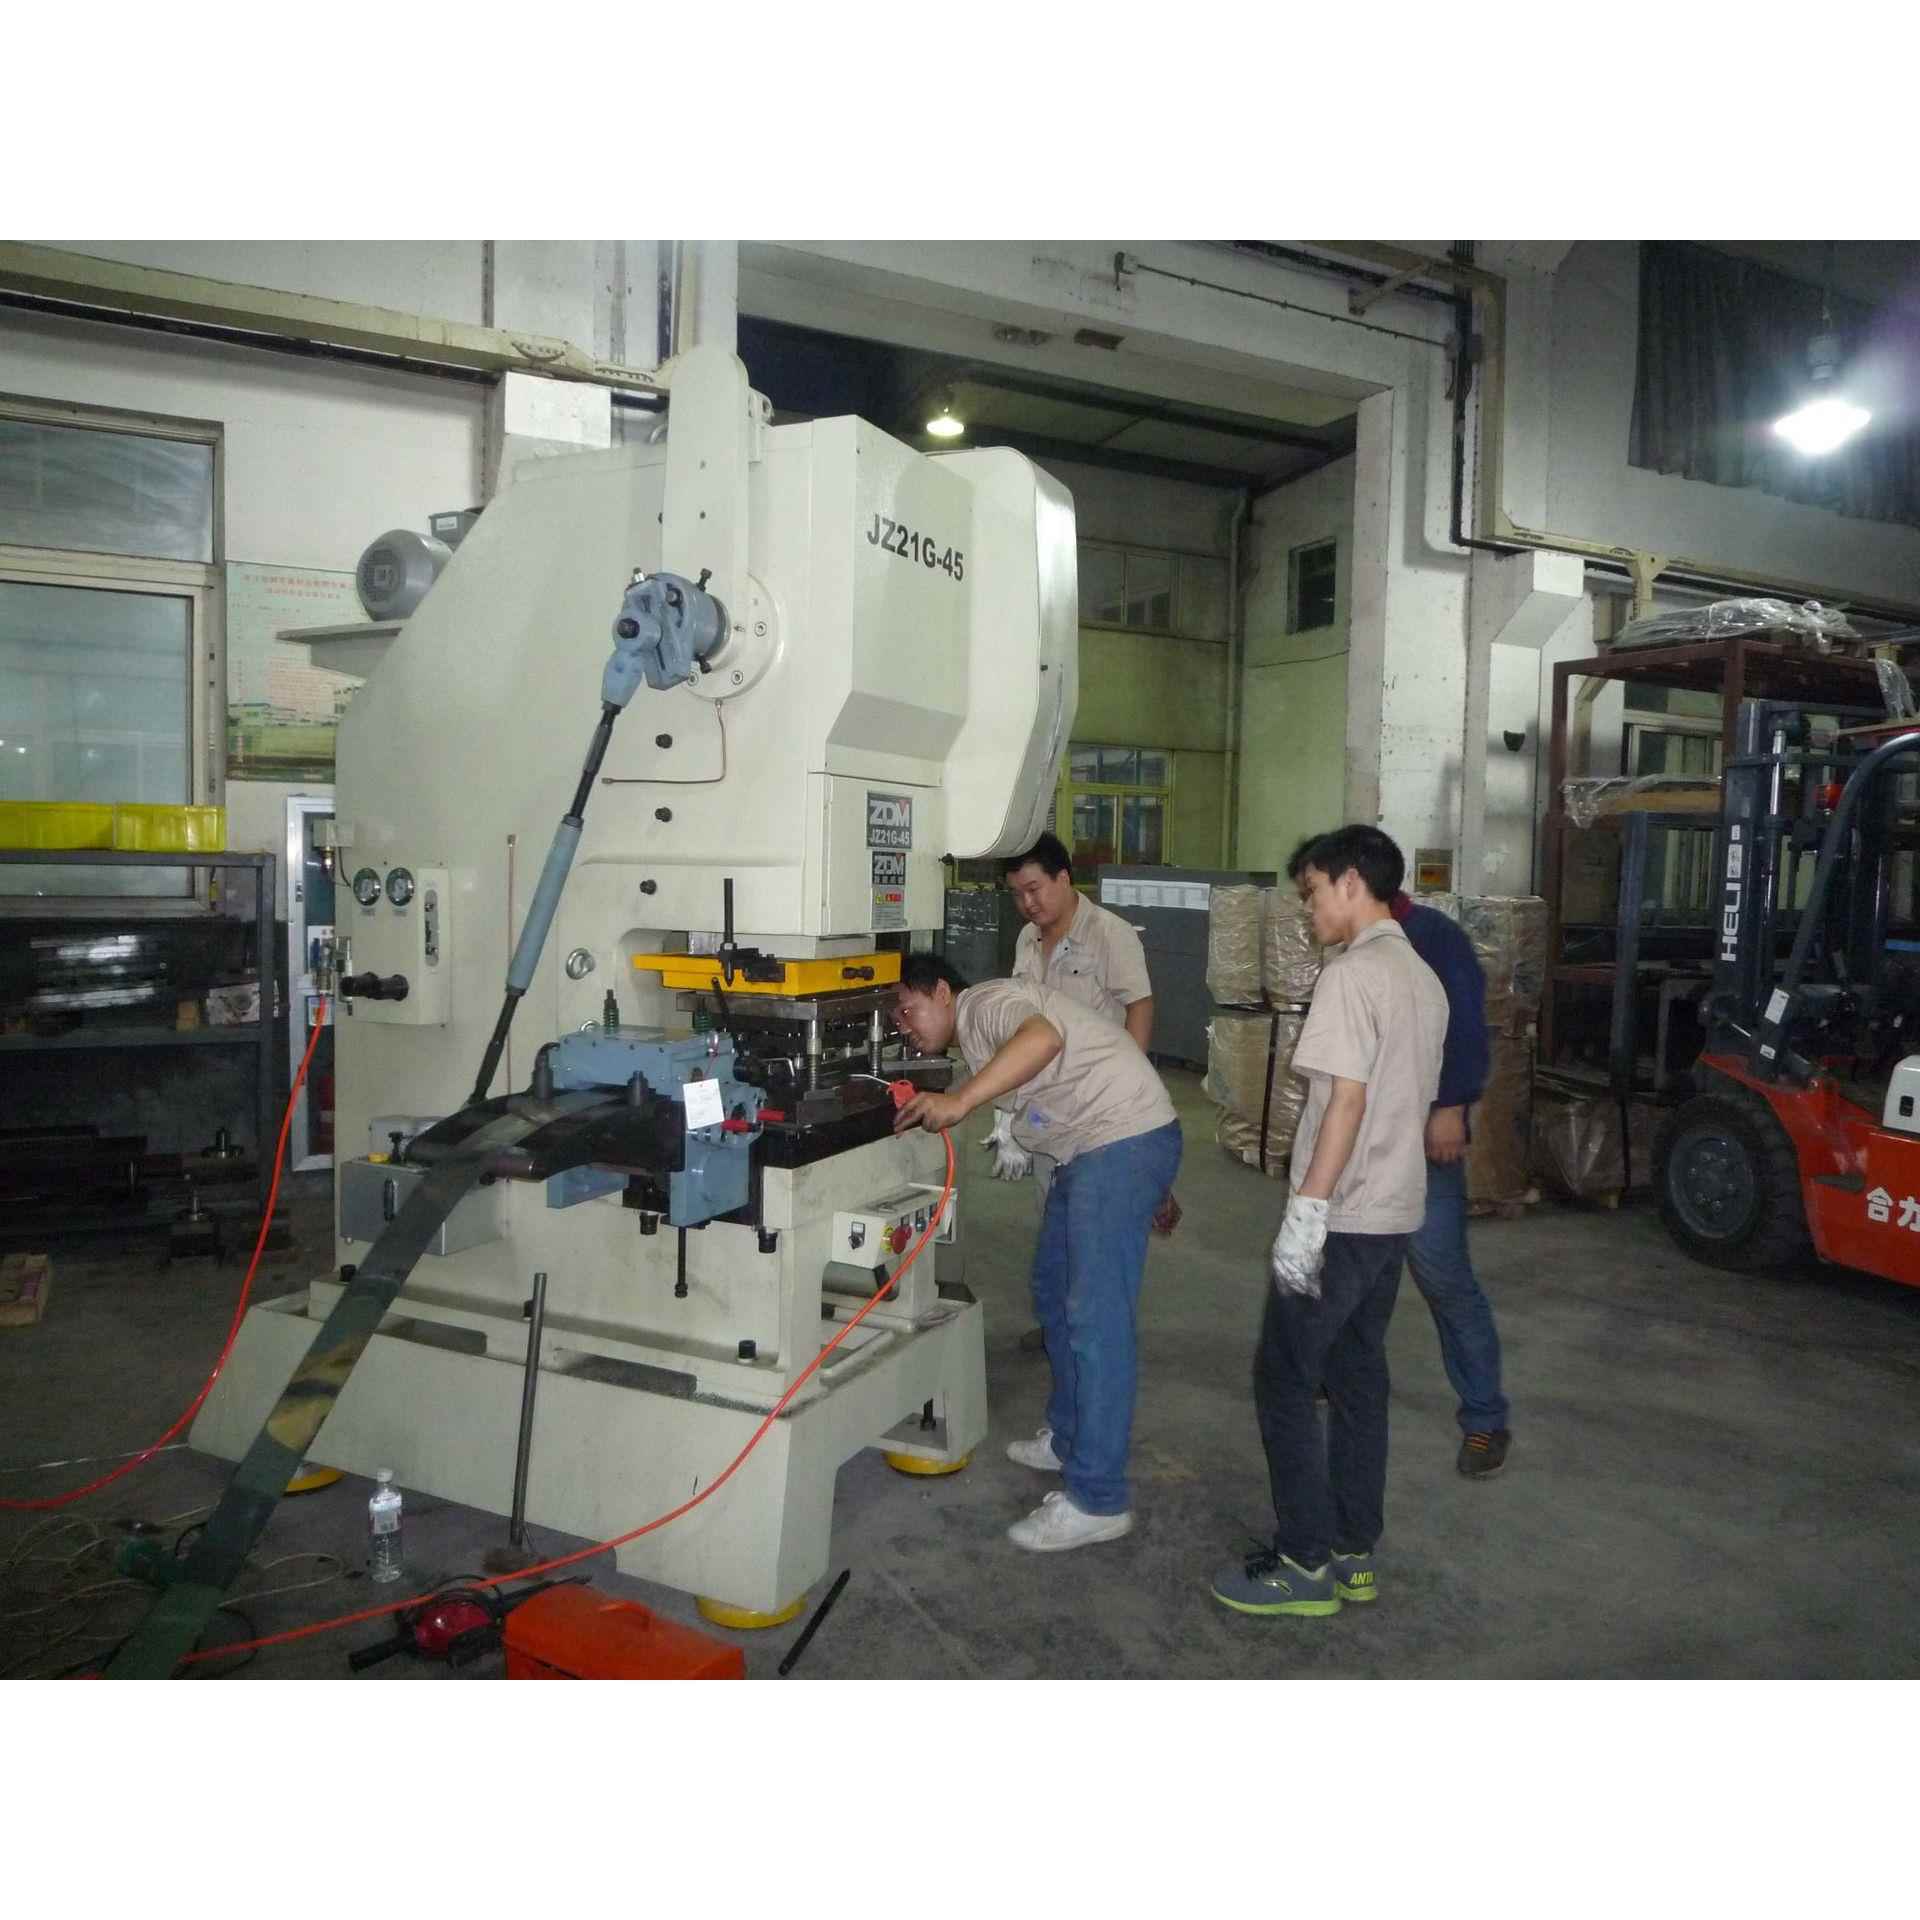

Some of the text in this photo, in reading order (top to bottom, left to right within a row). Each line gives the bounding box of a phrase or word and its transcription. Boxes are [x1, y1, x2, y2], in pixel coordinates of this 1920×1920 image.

[867, 513, 963, 582] JZ21G-45
[870, 800, 910, 827] ZDM
[871, 828, 910, 846] JZ21G-45
[874, 855, 904, 875] ZDM
[1721, 882, 1741, 962] HELI
